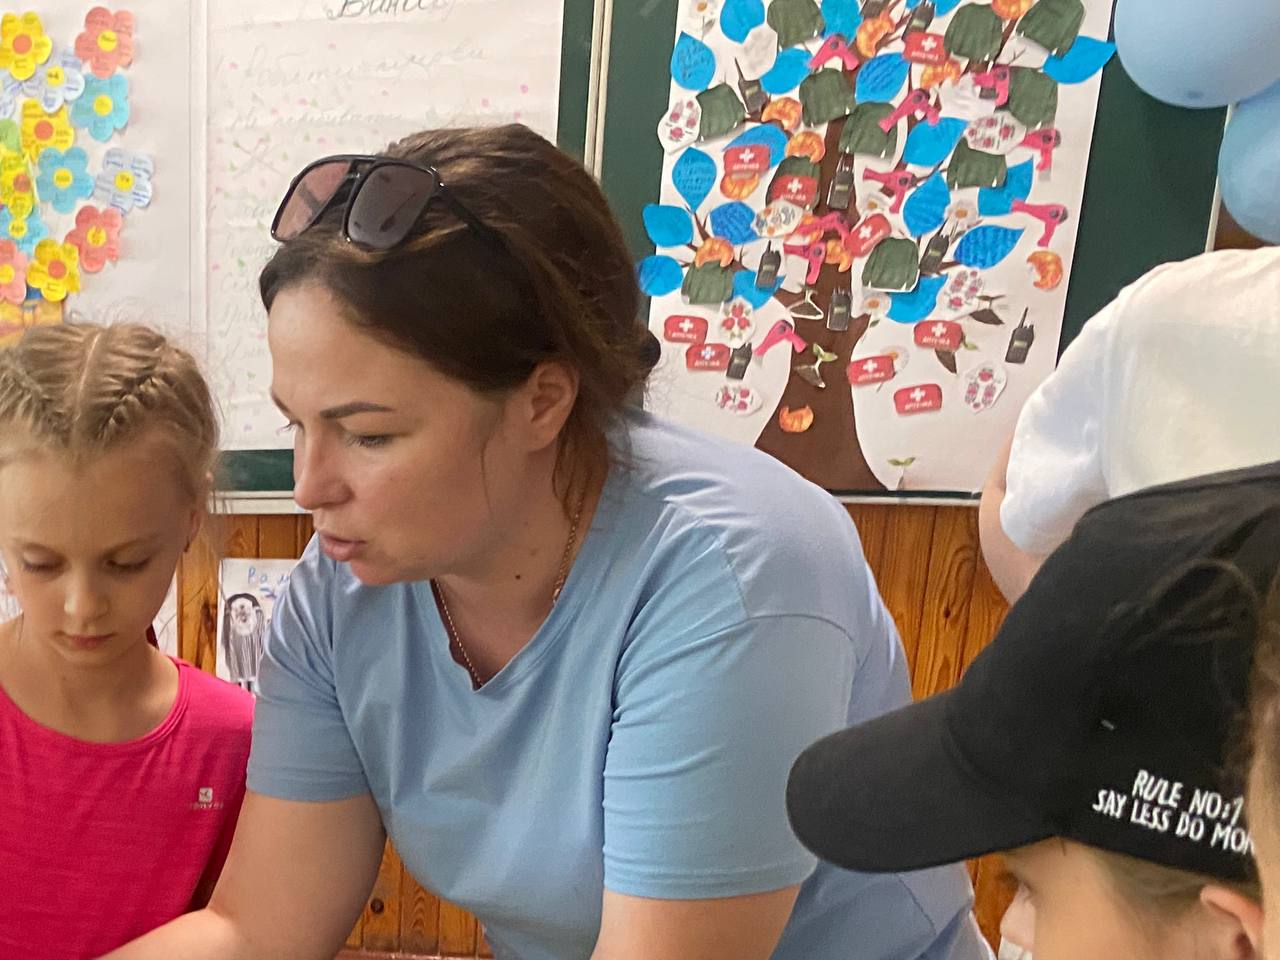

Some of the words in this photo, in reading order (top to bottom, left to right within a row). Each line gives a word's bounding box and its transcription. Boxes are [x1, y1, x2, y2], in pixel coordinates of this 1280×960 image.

[1131, 769, 1184, 809] RULE
[1092, 789, 1127, 819] SAY
[1130, 799, 1171, 833] LESS
[1175, 811, 1205, 842] DO
